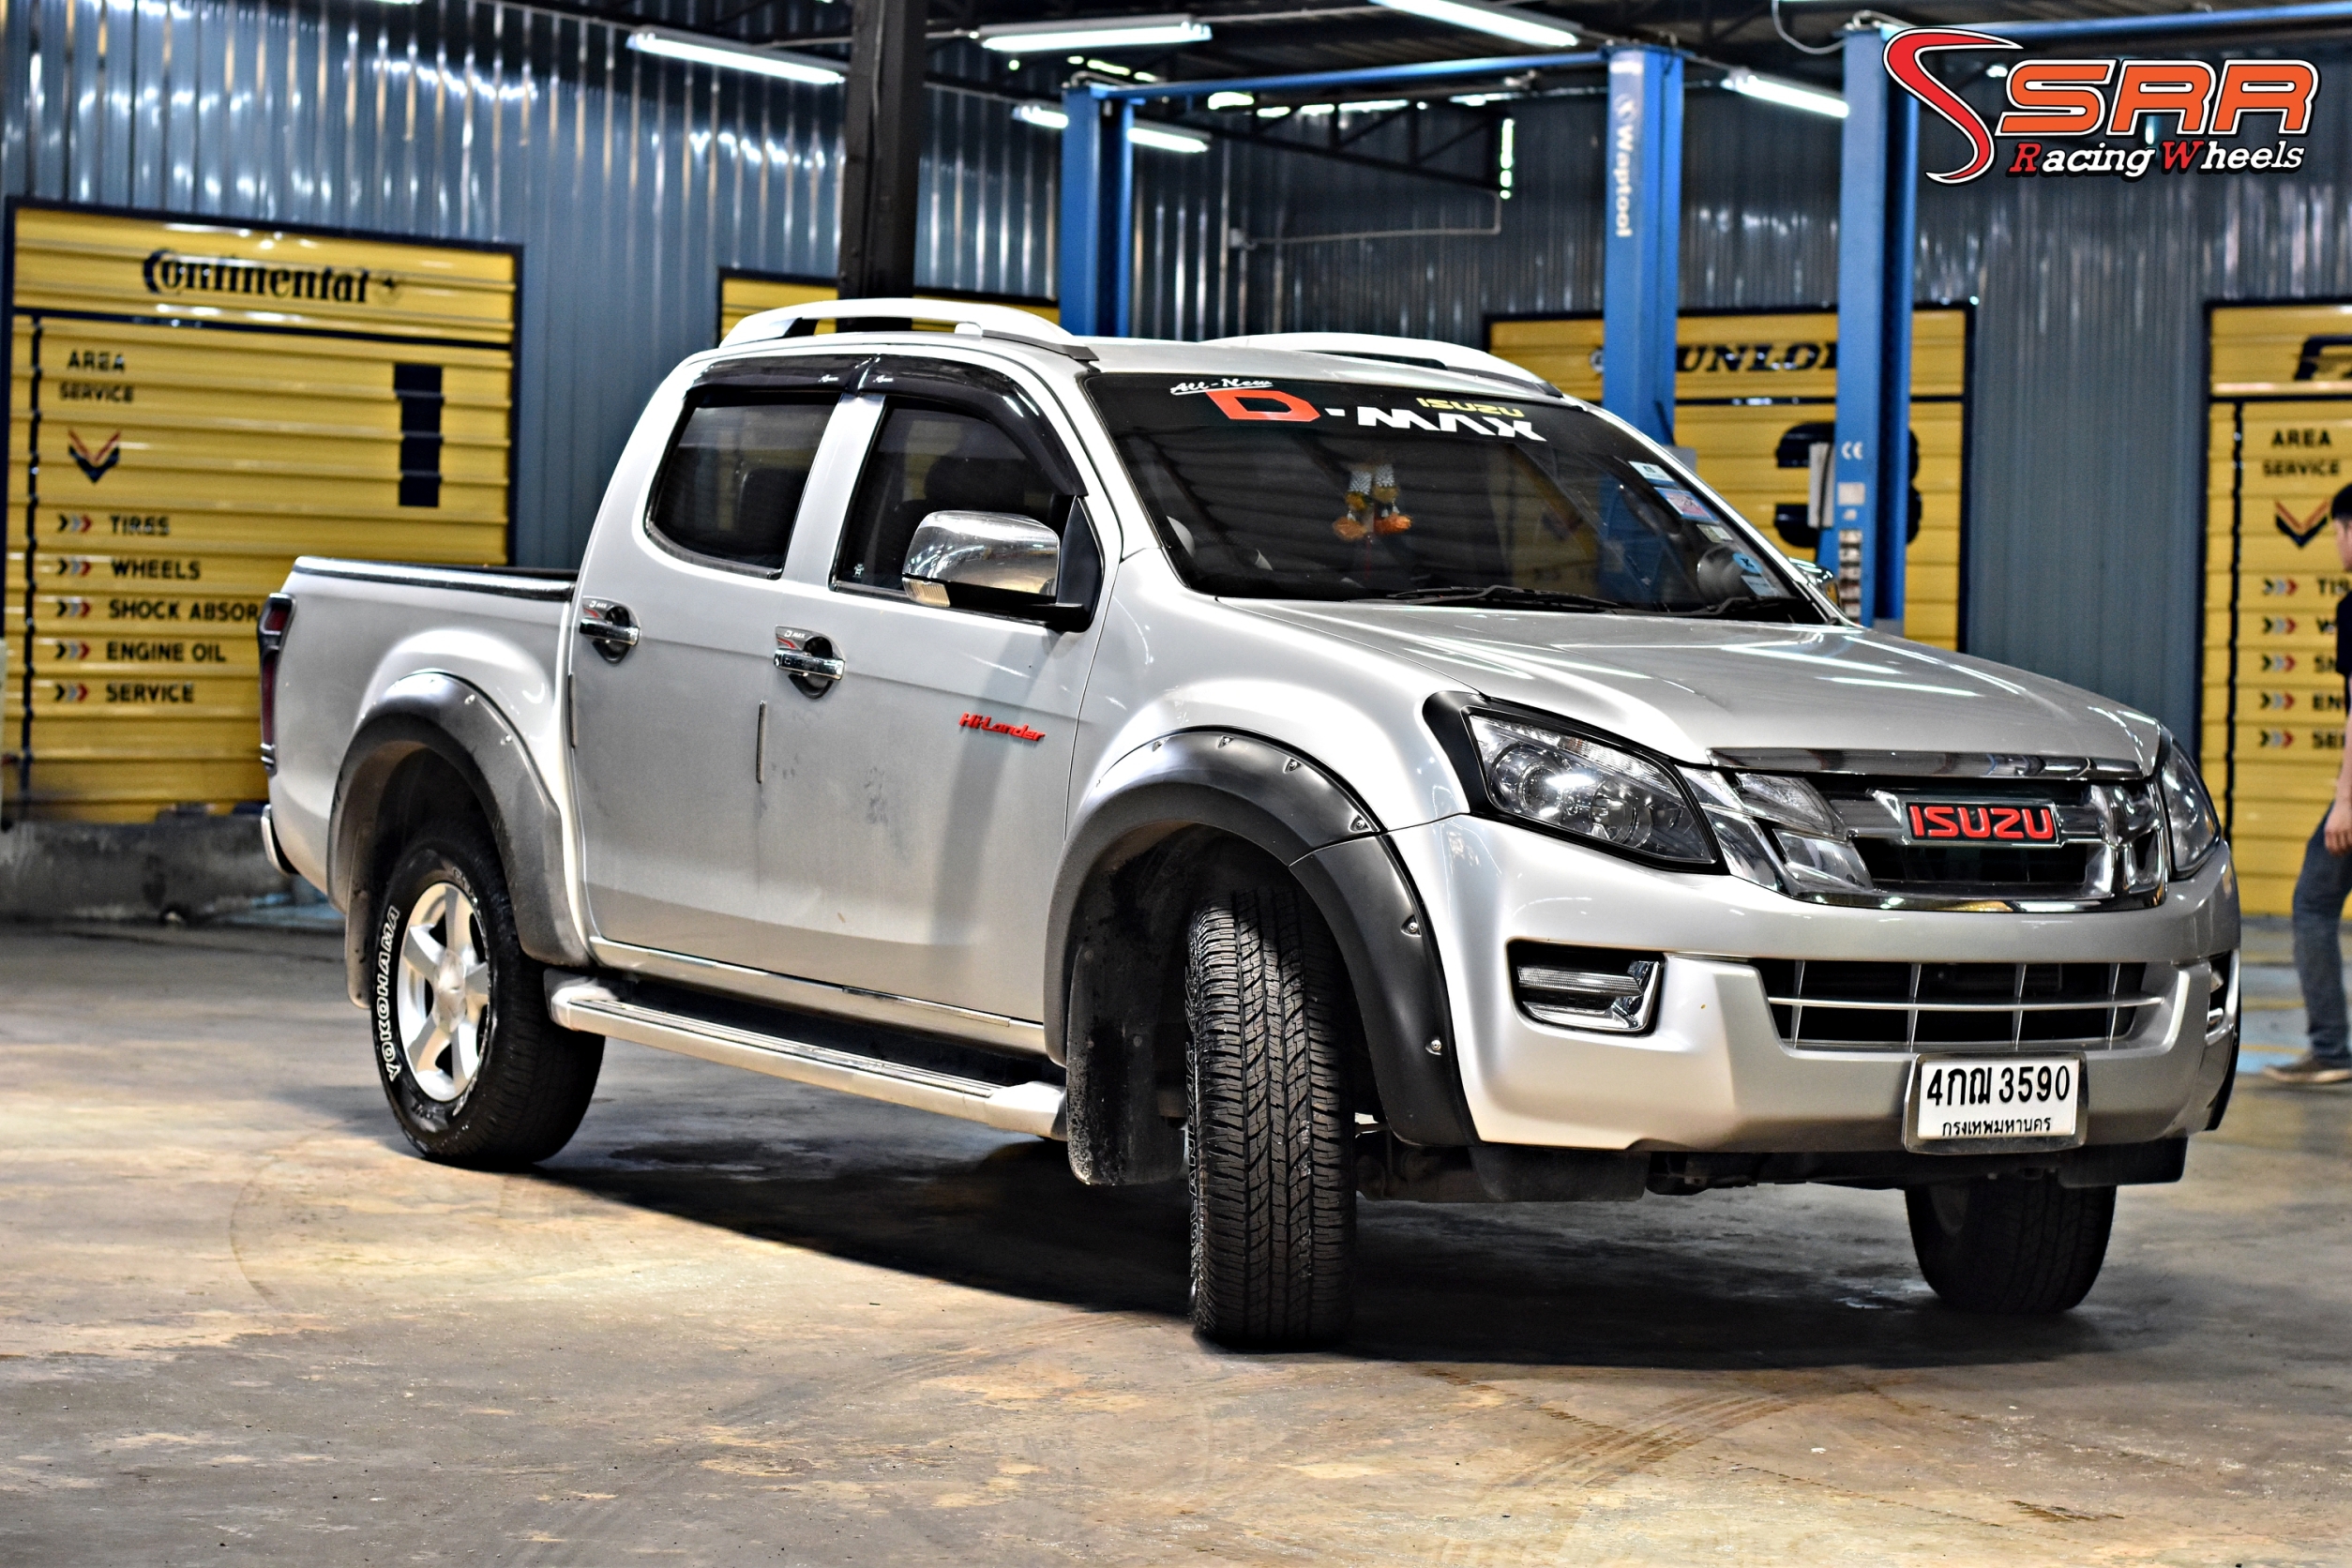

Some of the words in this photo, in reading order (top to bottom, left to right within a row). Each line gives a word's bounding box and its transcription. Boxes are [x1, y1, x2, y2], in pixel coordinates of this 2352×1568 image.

[143, 248, 369, 303] Continental
[67, 350, 126, 373] AREA
[58, 380, 134, 404] SERVICE
[1417, 397, 1525, 418] ISUZU
[2271, 428, 2332, 447] AREA
[111, 515, 171, 536] TIRES
[111, 558, 202, 580] WHEELS
[109, 598, 181, 620] SHOCK
[189, 601, 259, 623] ABSOR
[106, 641, 185, 663] ENGINE
[190, 642, 227, 663] OIL
[106, 682, 194, 703] SERVICE
[1909, 805, 2054, 839] ISUZU
[376, 905, 400, 1082] YOKOHAMA
[1998, 1065, 2071, 1104] 3590
[1942, 1117, 2052, 1137] กรงเทพมหานคร
